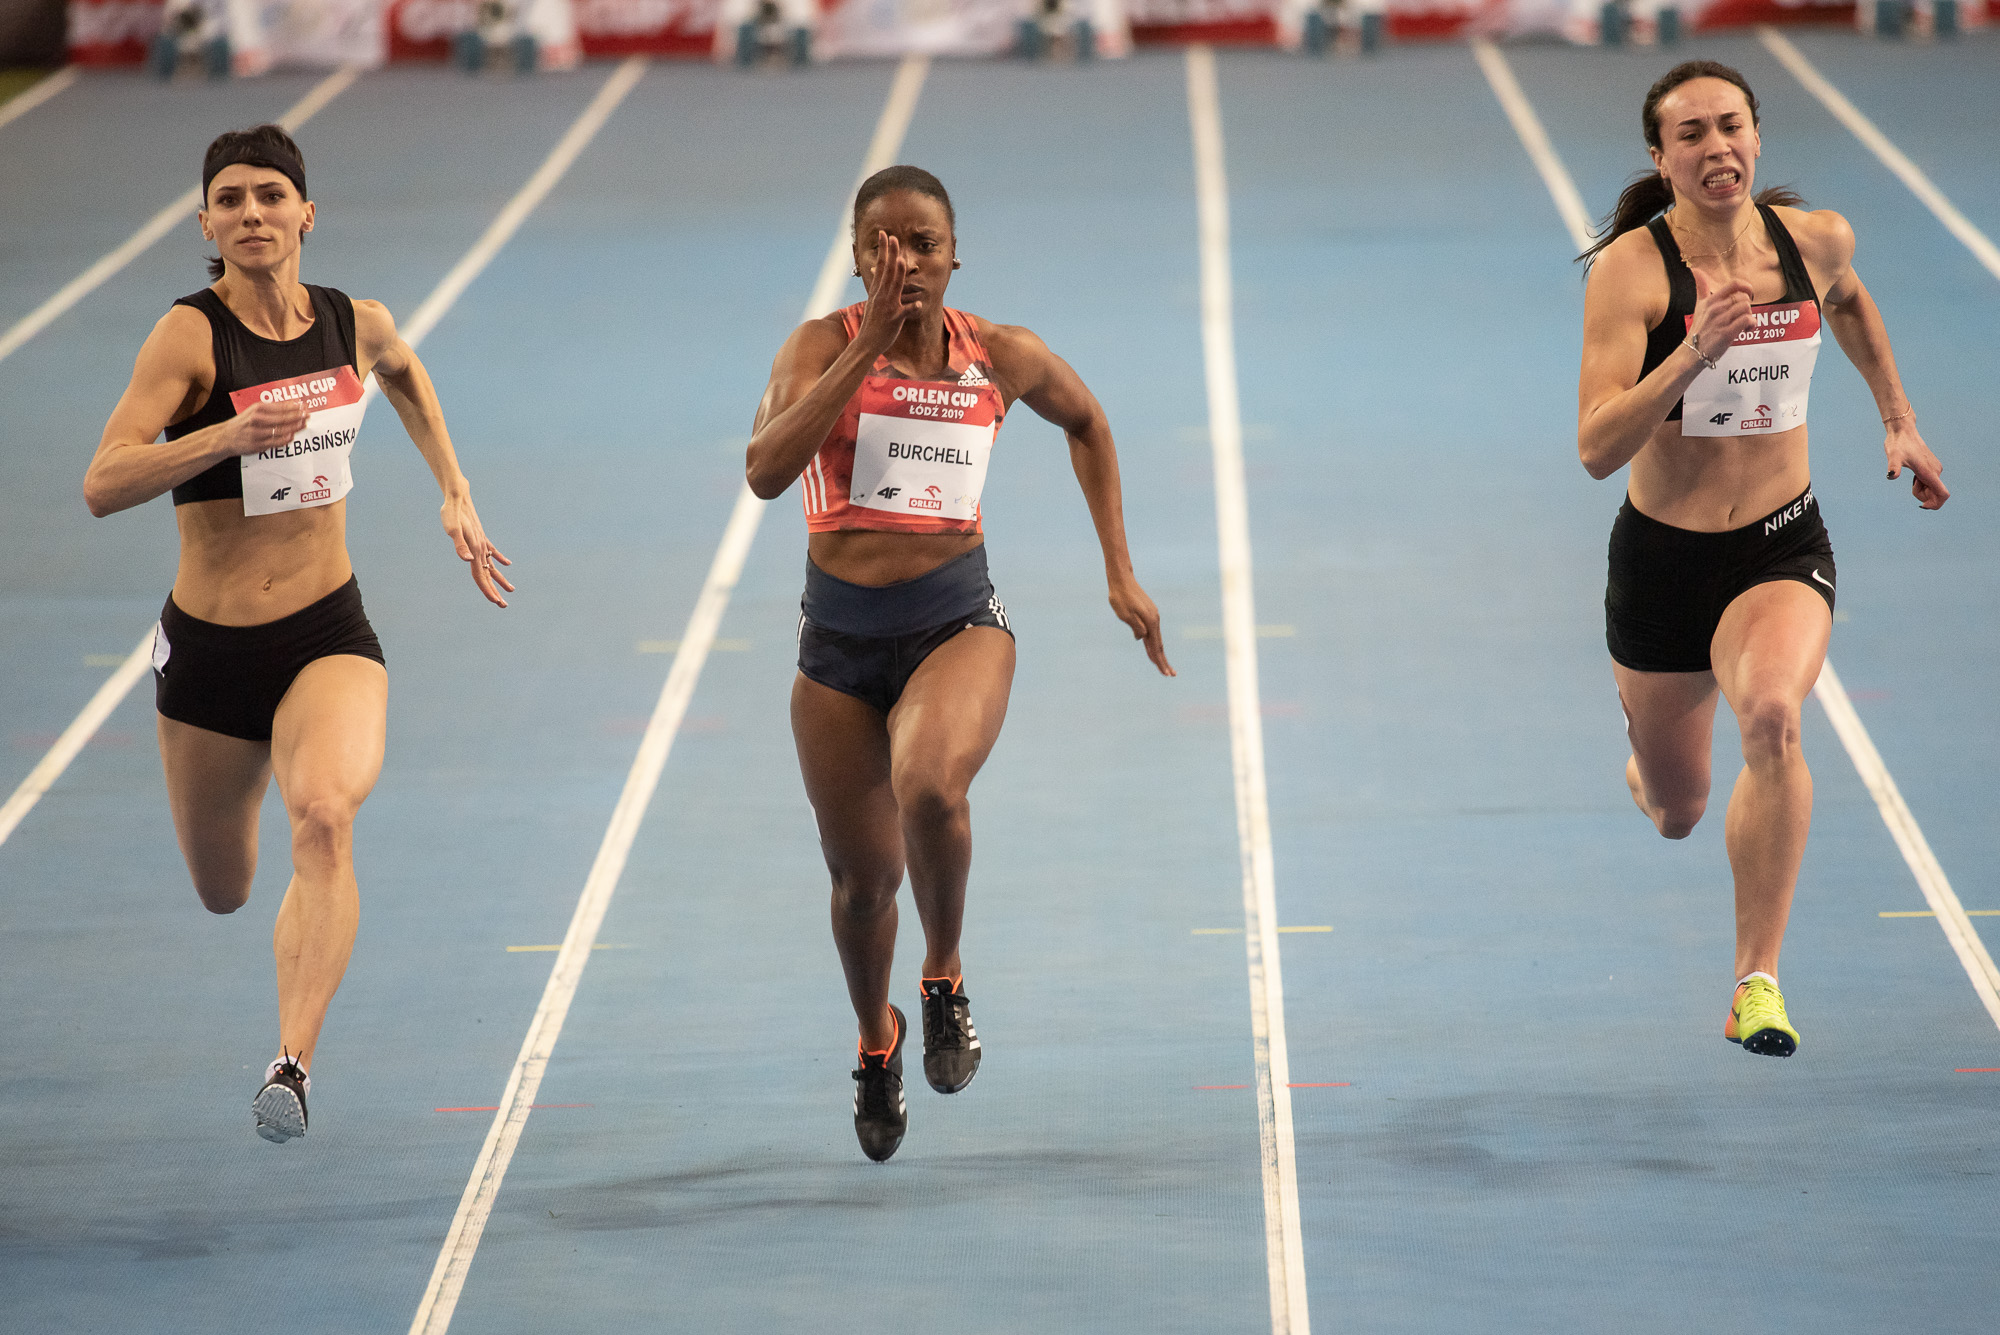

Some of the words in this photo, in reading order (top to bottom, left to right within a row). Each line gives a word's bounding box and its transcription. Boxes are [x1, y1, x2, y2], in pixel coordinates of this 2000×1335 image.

[1771, 309, 1800, 325] CUP
[1762, 328, 1786, 339] 2019
[1728, 364, 1790, 384] KACHUR
[957, 377, 989, 387] adidas
[260, 383, 308, 403] ORLEN
[310, 377, 337, 394] CUP
[893, 386, 950, 405] ORLEN
[951, 391, 978, 408] CUP
[307, 396, 327, 408] 2019
[909, 404, 939, 417] ŁÓDŹ
[942, 408, 964, 419] 2019
[1709, 413, 1733, 425] 4F
[1742, 419, 1770, 429] ORLEN
[888, 442, 973, 465] BURCHELL
[270, 486, 292, 501] 4F
[301, 489, 330, 502] ORLEN
[877, 487, 901, 499] 4F
[910, 498, 940, 509] ORLEN
[1765, 500, 1802, 536] NIKE
